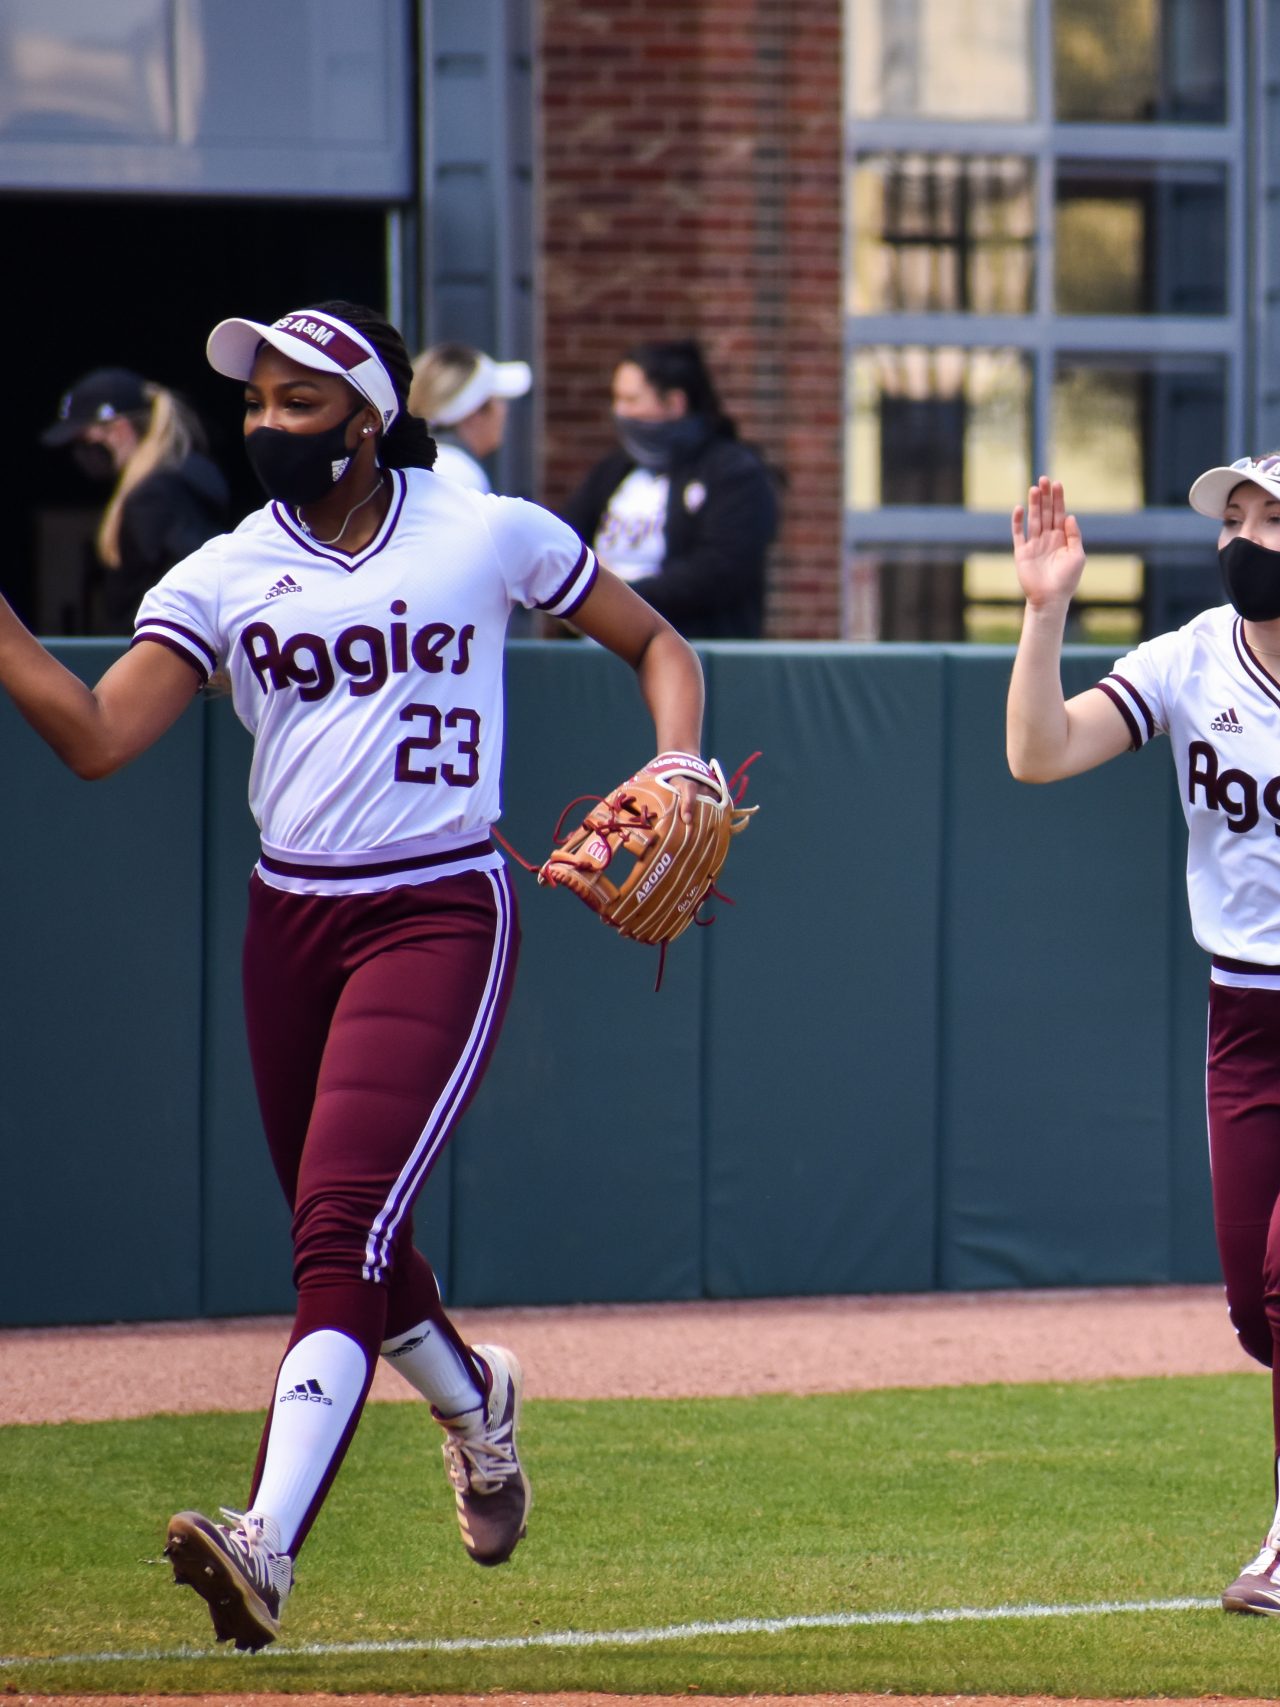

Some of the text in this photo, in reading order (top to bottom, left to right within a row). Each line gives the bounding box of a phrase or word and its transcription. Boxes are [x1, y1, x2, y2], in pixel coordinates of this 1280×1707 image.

[288, 318, 336, 346] A&M
[240, 600, 475, 702] Aggies
[394, 702, 481, 788] 23
[1210, 721, 1243, 734] adidas
[636, 853, 671, 904] A2000
[280, 1390, 333, 1406] adidas
